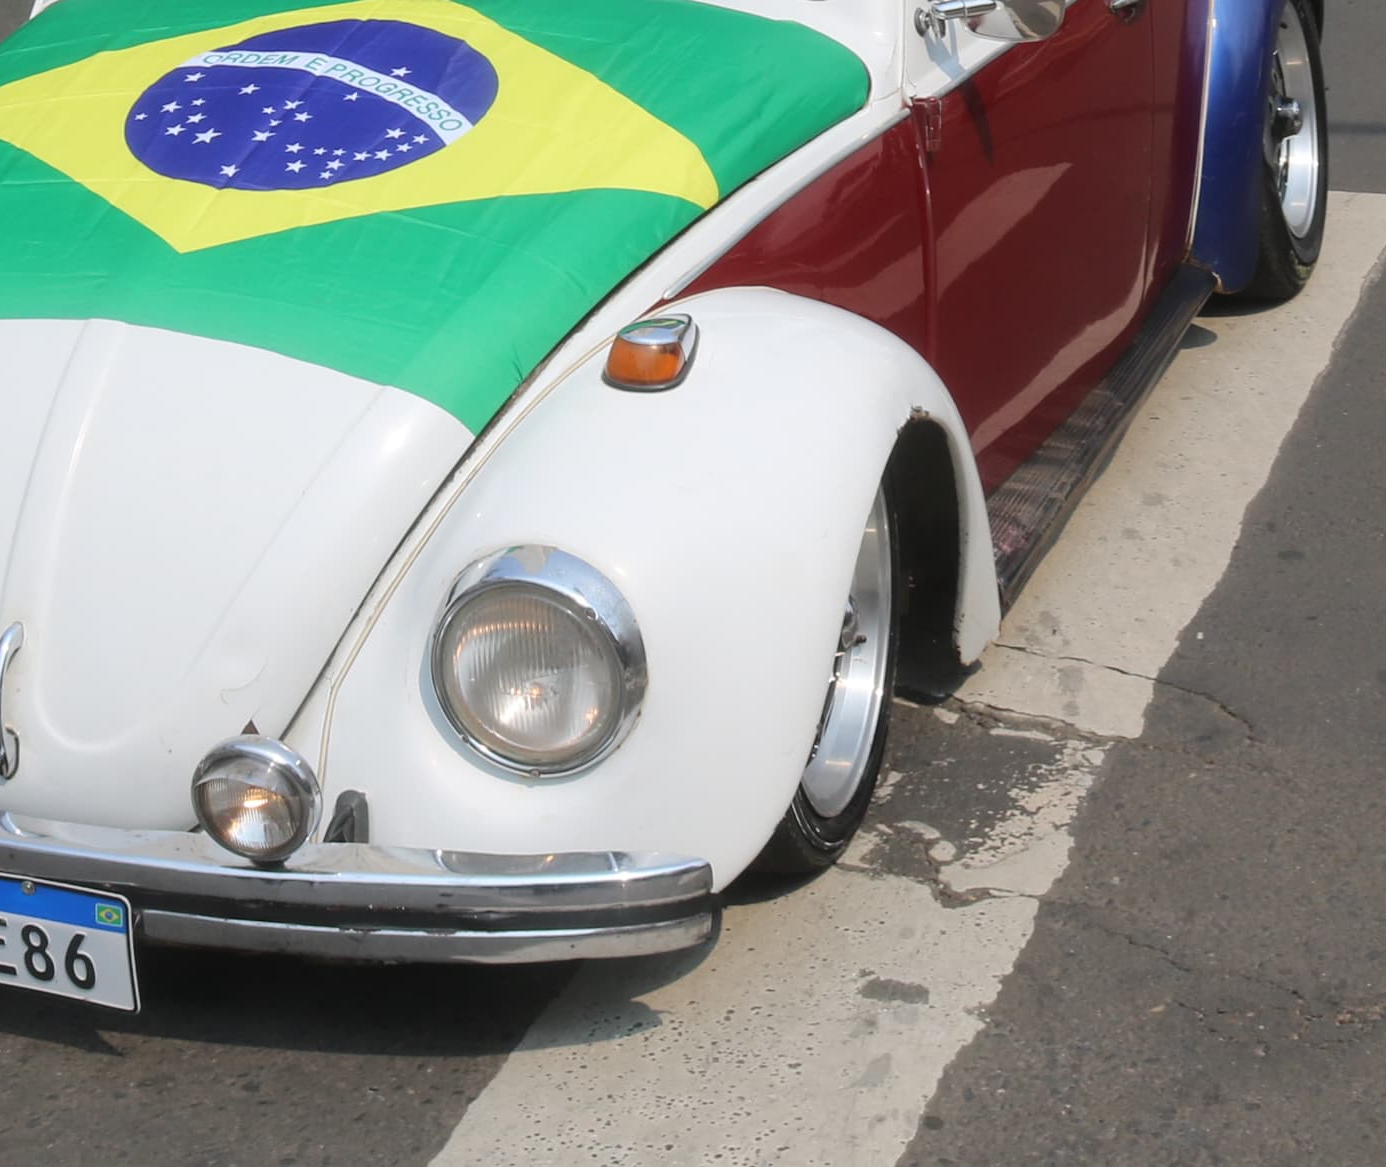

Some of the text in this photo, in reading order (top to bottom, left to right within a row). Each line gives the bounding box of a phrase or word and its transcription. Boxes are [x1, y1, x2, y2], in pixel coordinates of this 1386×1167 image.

[202, 51, 466, 134] ORDEM E PROGRESSO
